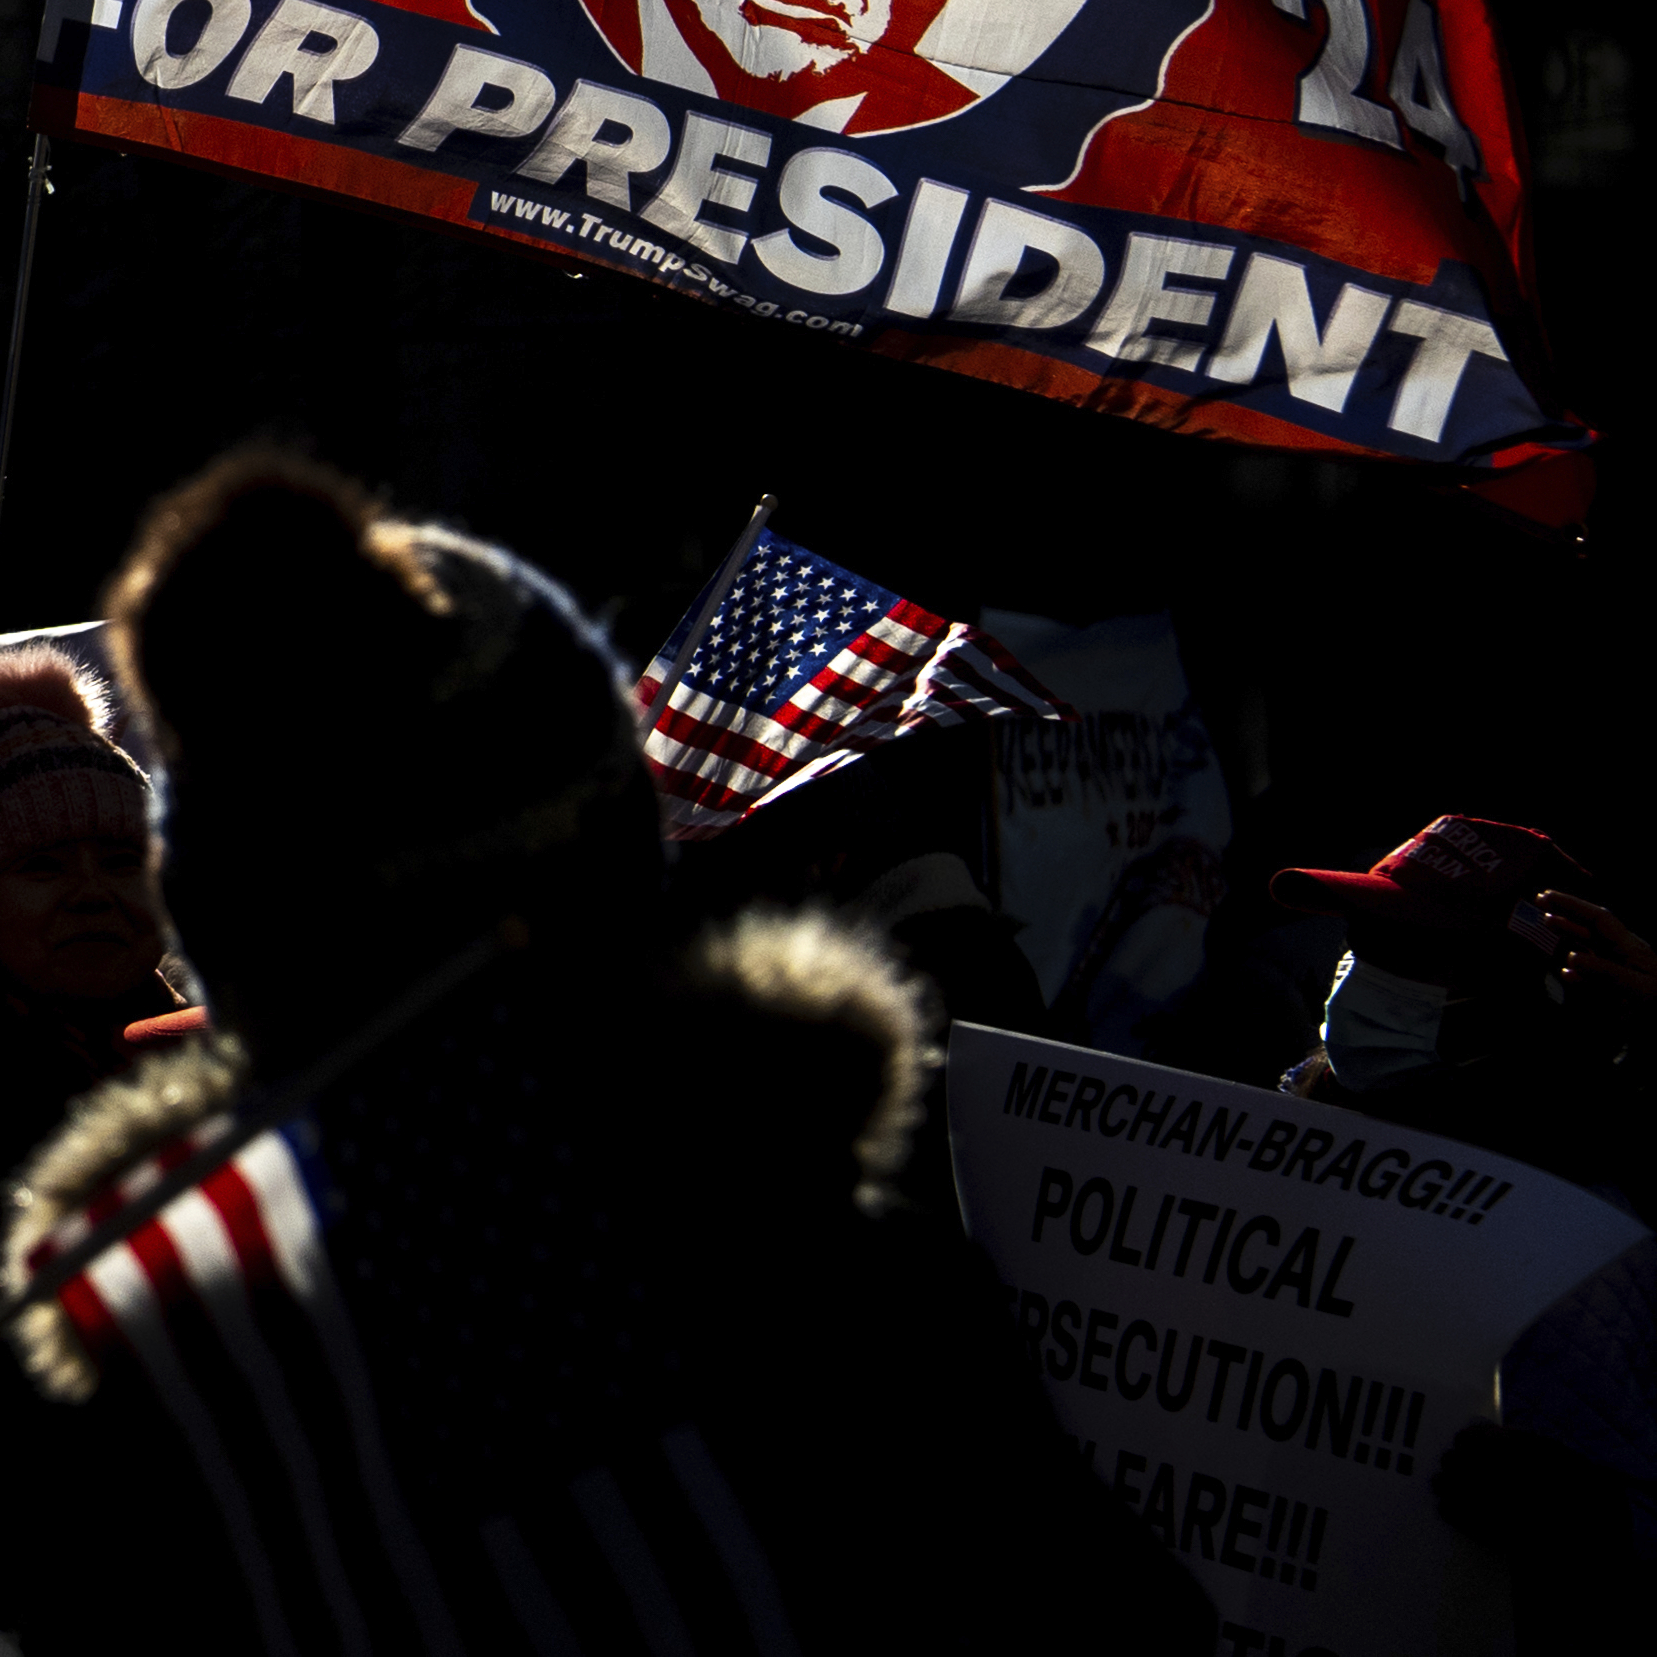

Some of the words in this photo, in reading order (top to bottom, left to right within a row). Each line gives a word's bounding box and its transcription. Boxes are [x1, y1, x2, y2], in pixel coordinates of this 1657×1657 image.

[396, 44, 1510, 442] PRESIDENT
[1003, 1062, 1511, 1224] MERCHAN-BRAGG!!!
[1032, 1166, 1354, 1317] POLITICAL
[1003, 1285, 1425, 1476] RSECUTION!!!
